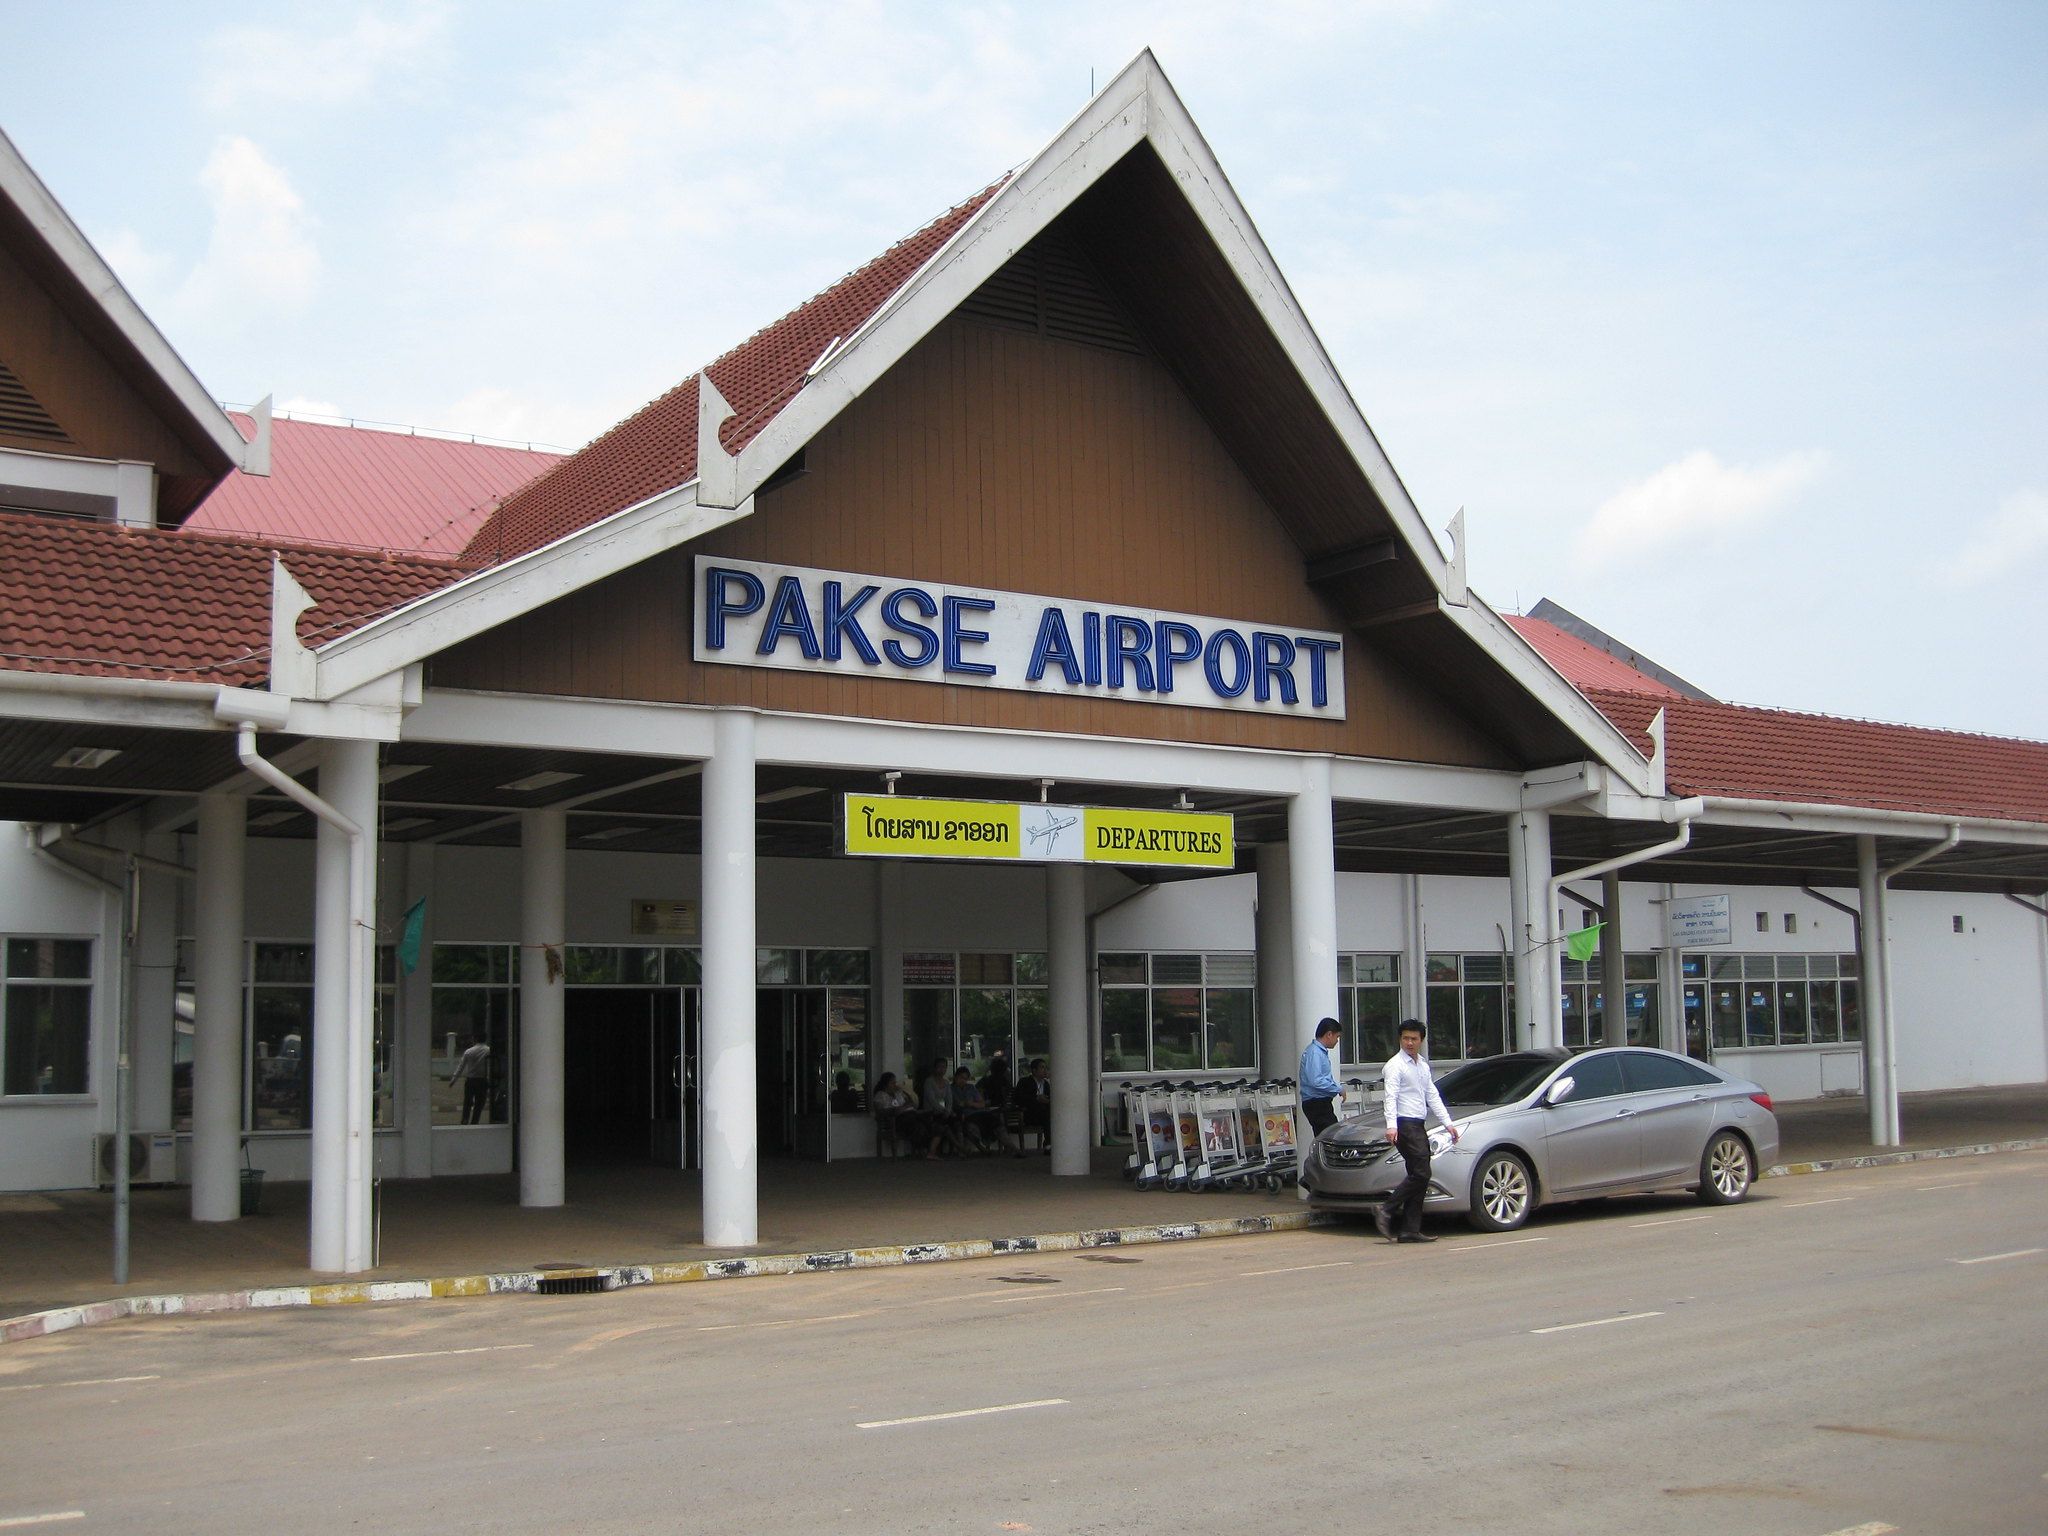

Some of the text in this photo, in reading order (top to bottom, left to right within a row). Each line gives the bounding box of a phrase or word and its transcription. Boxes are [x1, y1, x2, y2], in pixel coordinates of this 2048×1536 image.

[706, 566, 1341, 708] PAKSE AIRPORT
[944, 820, 1009, 843] ຂາອອກ
[1096, 826, 1222, 854] DEPARTURES
